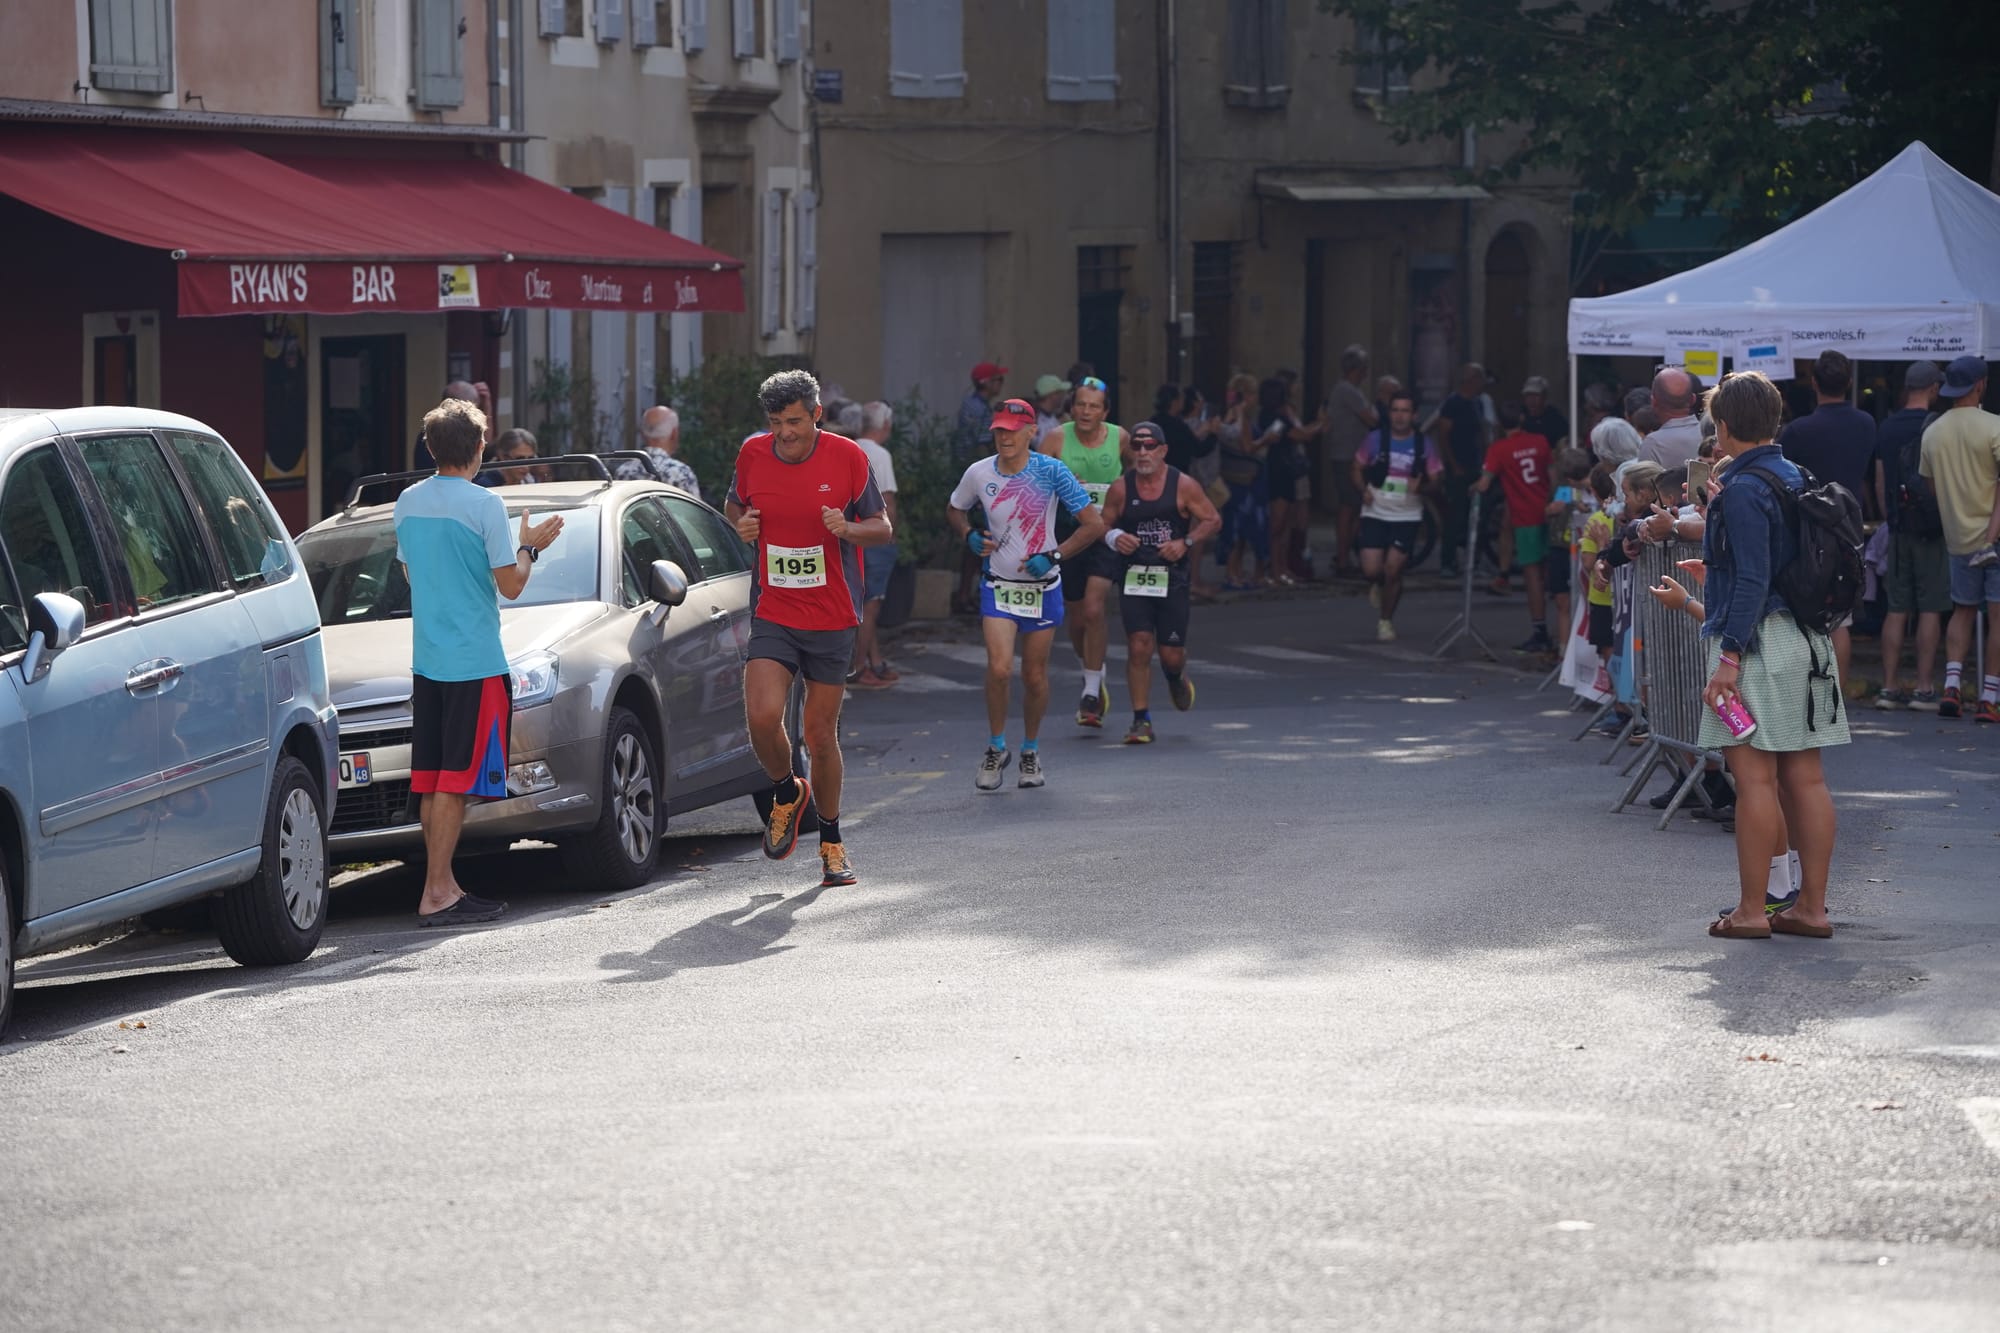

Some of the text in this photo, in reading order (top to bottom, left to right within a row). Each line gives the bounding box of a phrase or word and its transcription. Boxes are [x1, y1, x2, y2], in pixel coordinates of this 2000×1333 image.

[230, 264, 396, 304] RYAN'S BAR
[525, 268, 552, 300] Chez
[581, 275, 622, 302] Martine
[1520, 458, 1540, 484] 2
[775, 557, 817, 575] 195
[1137, 573, 1157, 587] 55
[1001, 590, 1036, 606] 139
[356, 769, 368, 781] 48
